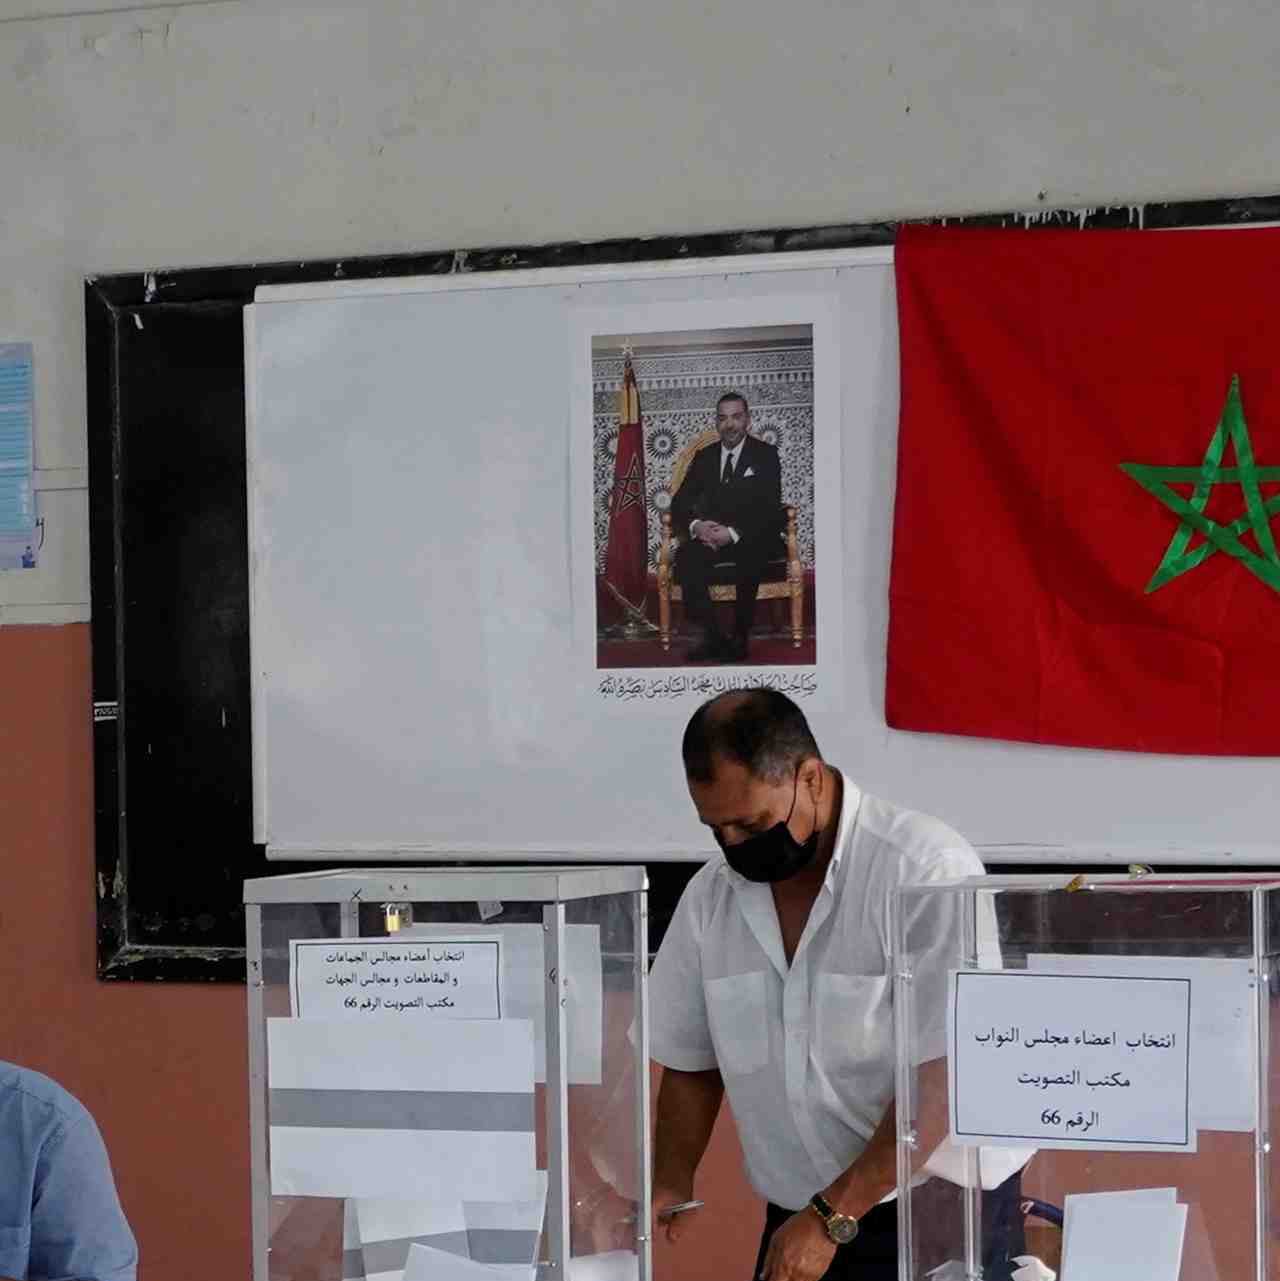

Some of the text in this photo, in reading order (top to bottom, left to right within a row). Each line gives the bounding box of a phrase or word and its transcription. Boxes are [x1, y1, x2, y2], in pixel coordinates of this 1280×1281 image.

[325, 948, 465, 965] انتخاب أعضاء مجالس الجماعات
[325, 972, 358, 986] الجهات
[403, 972, 450, 985] المقاطعات
[343, 996, 455, 1012] مكتب التصويت الرقم 66
[975, 1026, 1019, 1048] النواب
[1024, 1028, 1069, 1048] مجلس
[1125, 1032, 1176, 1051] انتخاب
[1017, 1069, 1131, 1090] مكتب التصويت
[1040, 1108, 1099, 1132] الرقم 66
